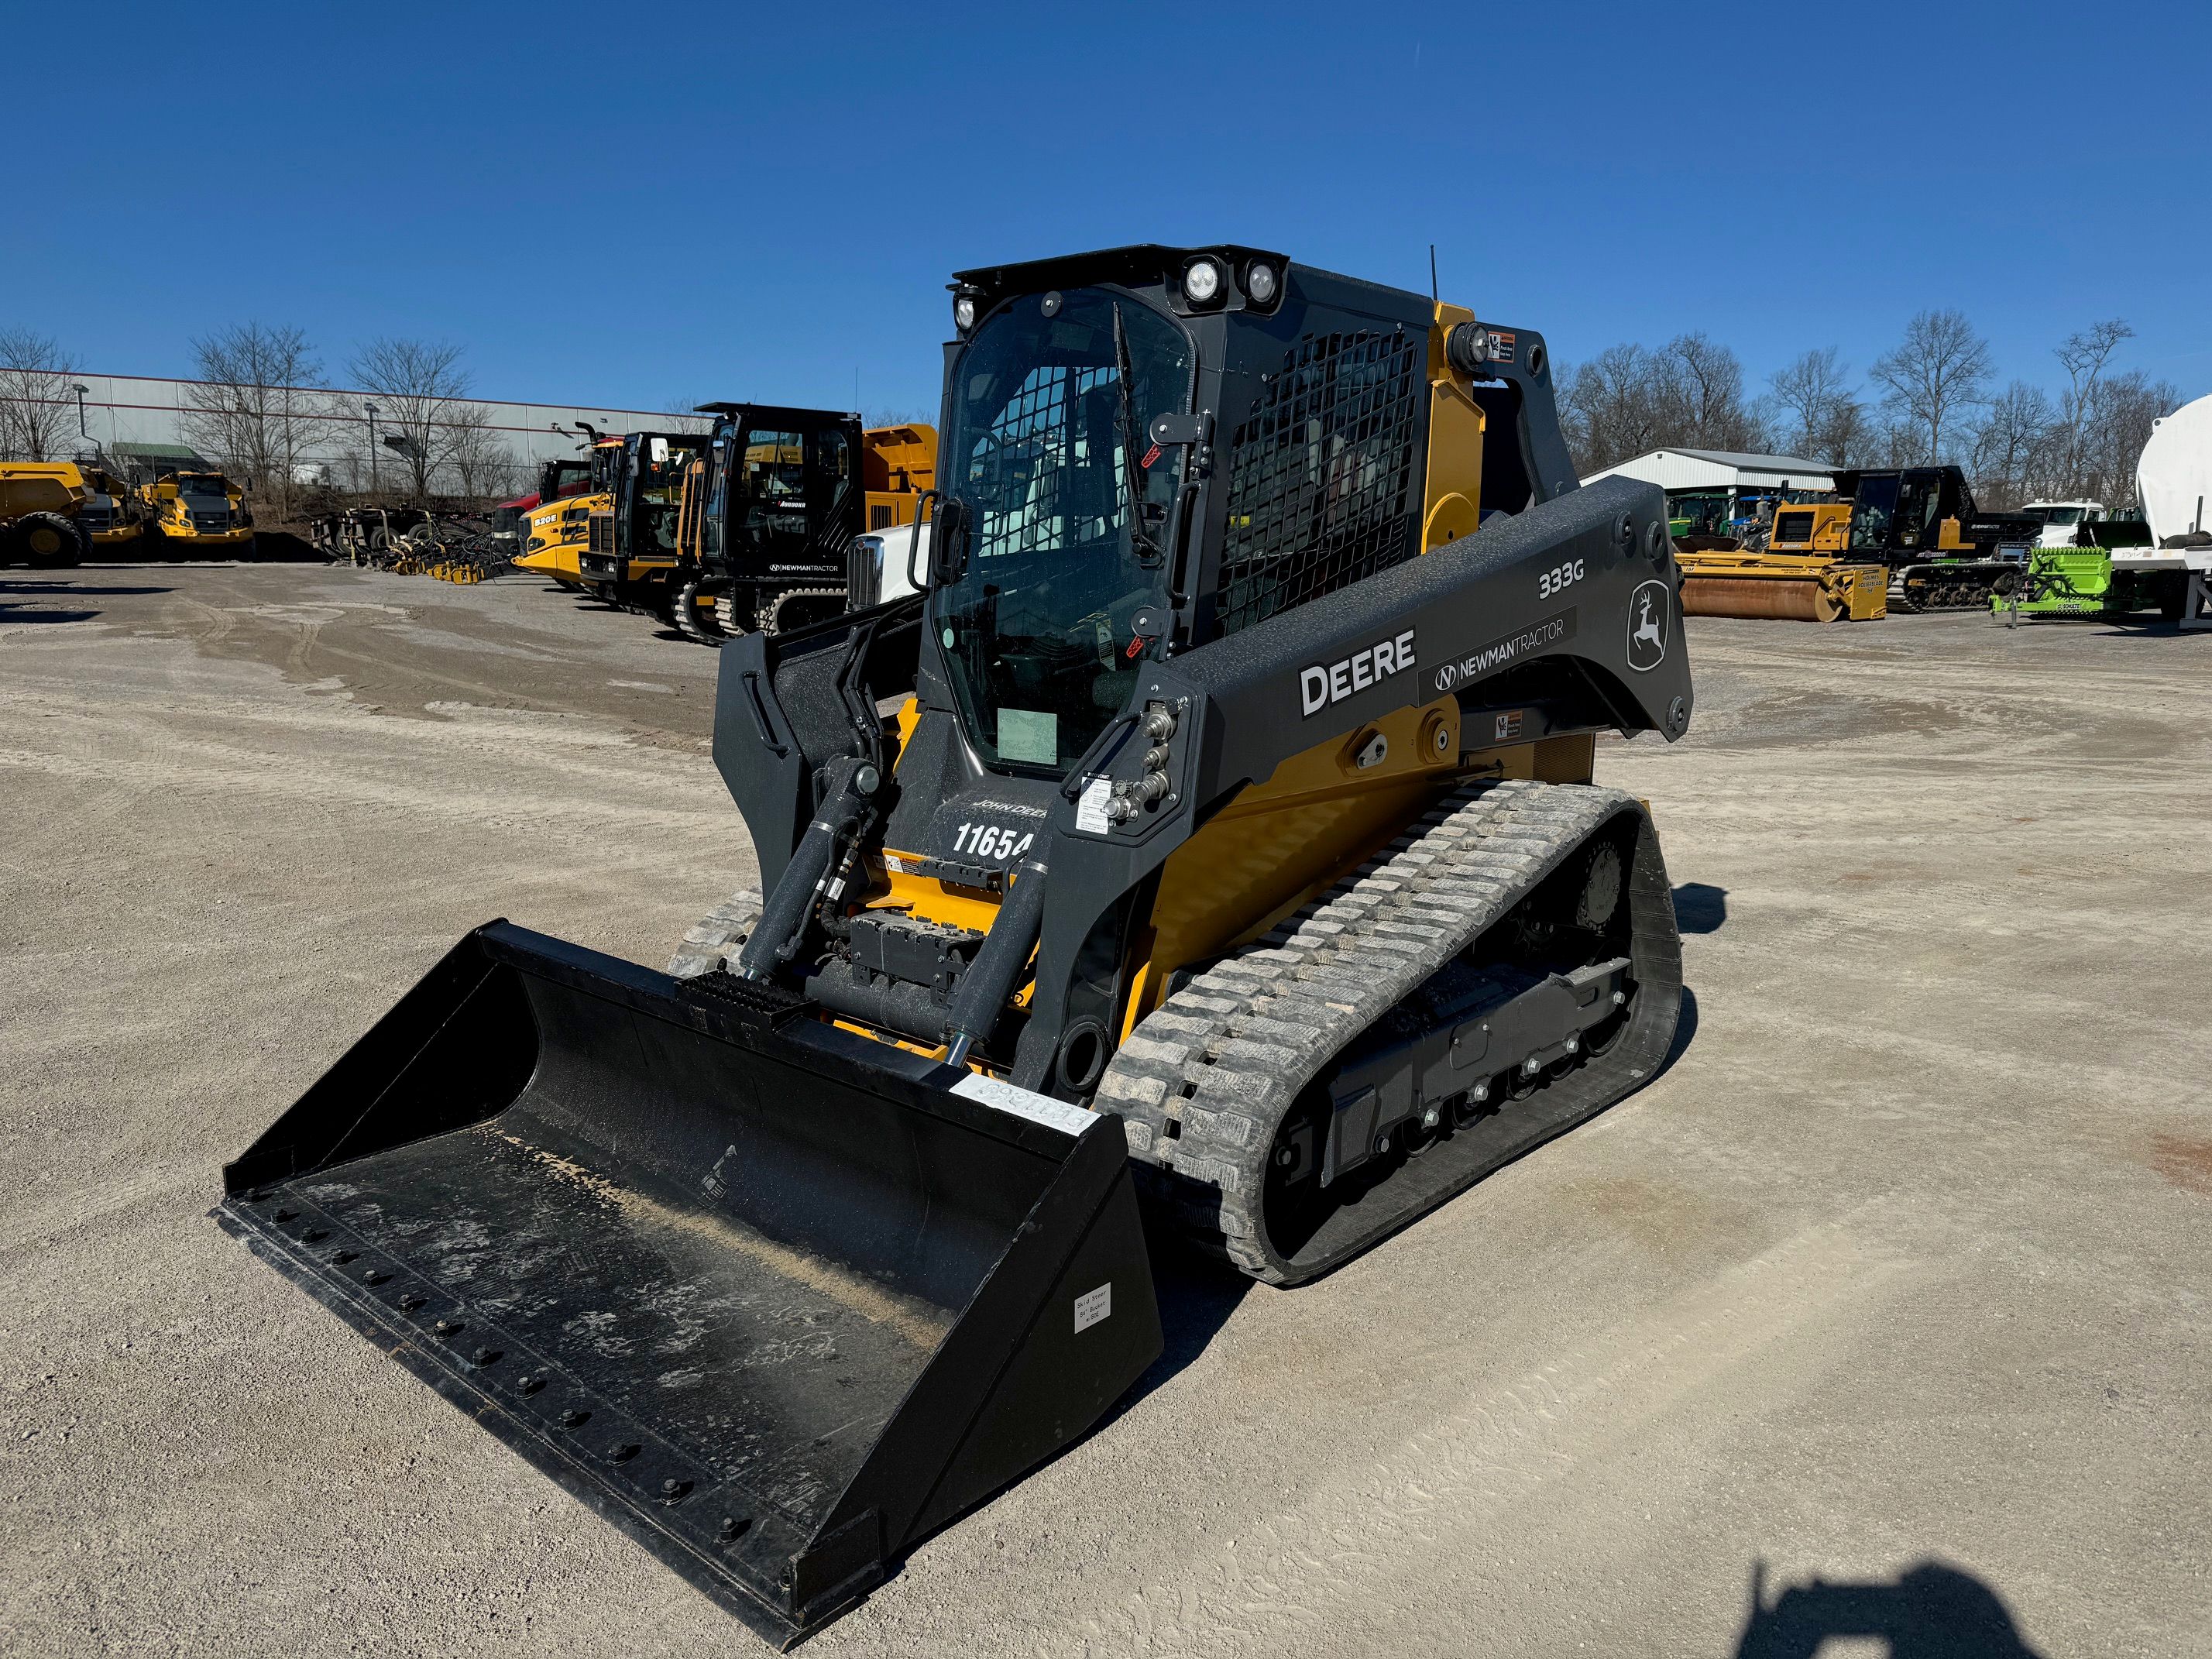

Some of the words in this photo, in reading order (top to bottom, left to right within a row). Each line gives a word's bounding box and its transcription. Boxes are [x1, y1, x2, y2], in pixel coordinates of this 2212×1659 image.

[534, 514, 557, 527] B20E
[1539, 558, 1584, 599] 333G
[1459, 618, 1564, 680] NEWMANTRACTOR
[1300, 629, 1416, 716] DEERE
[973, 799, 1014, 811] JOHN
[1011, 805, 1048, 818] DEER
[953, 823, 1034, 860] 11654
[1077, 1298, 1090, 1309] Skid
[1091, 1290, 1106, 1301] Steer
[1089, 1301, 1105, 1313] Bucket
